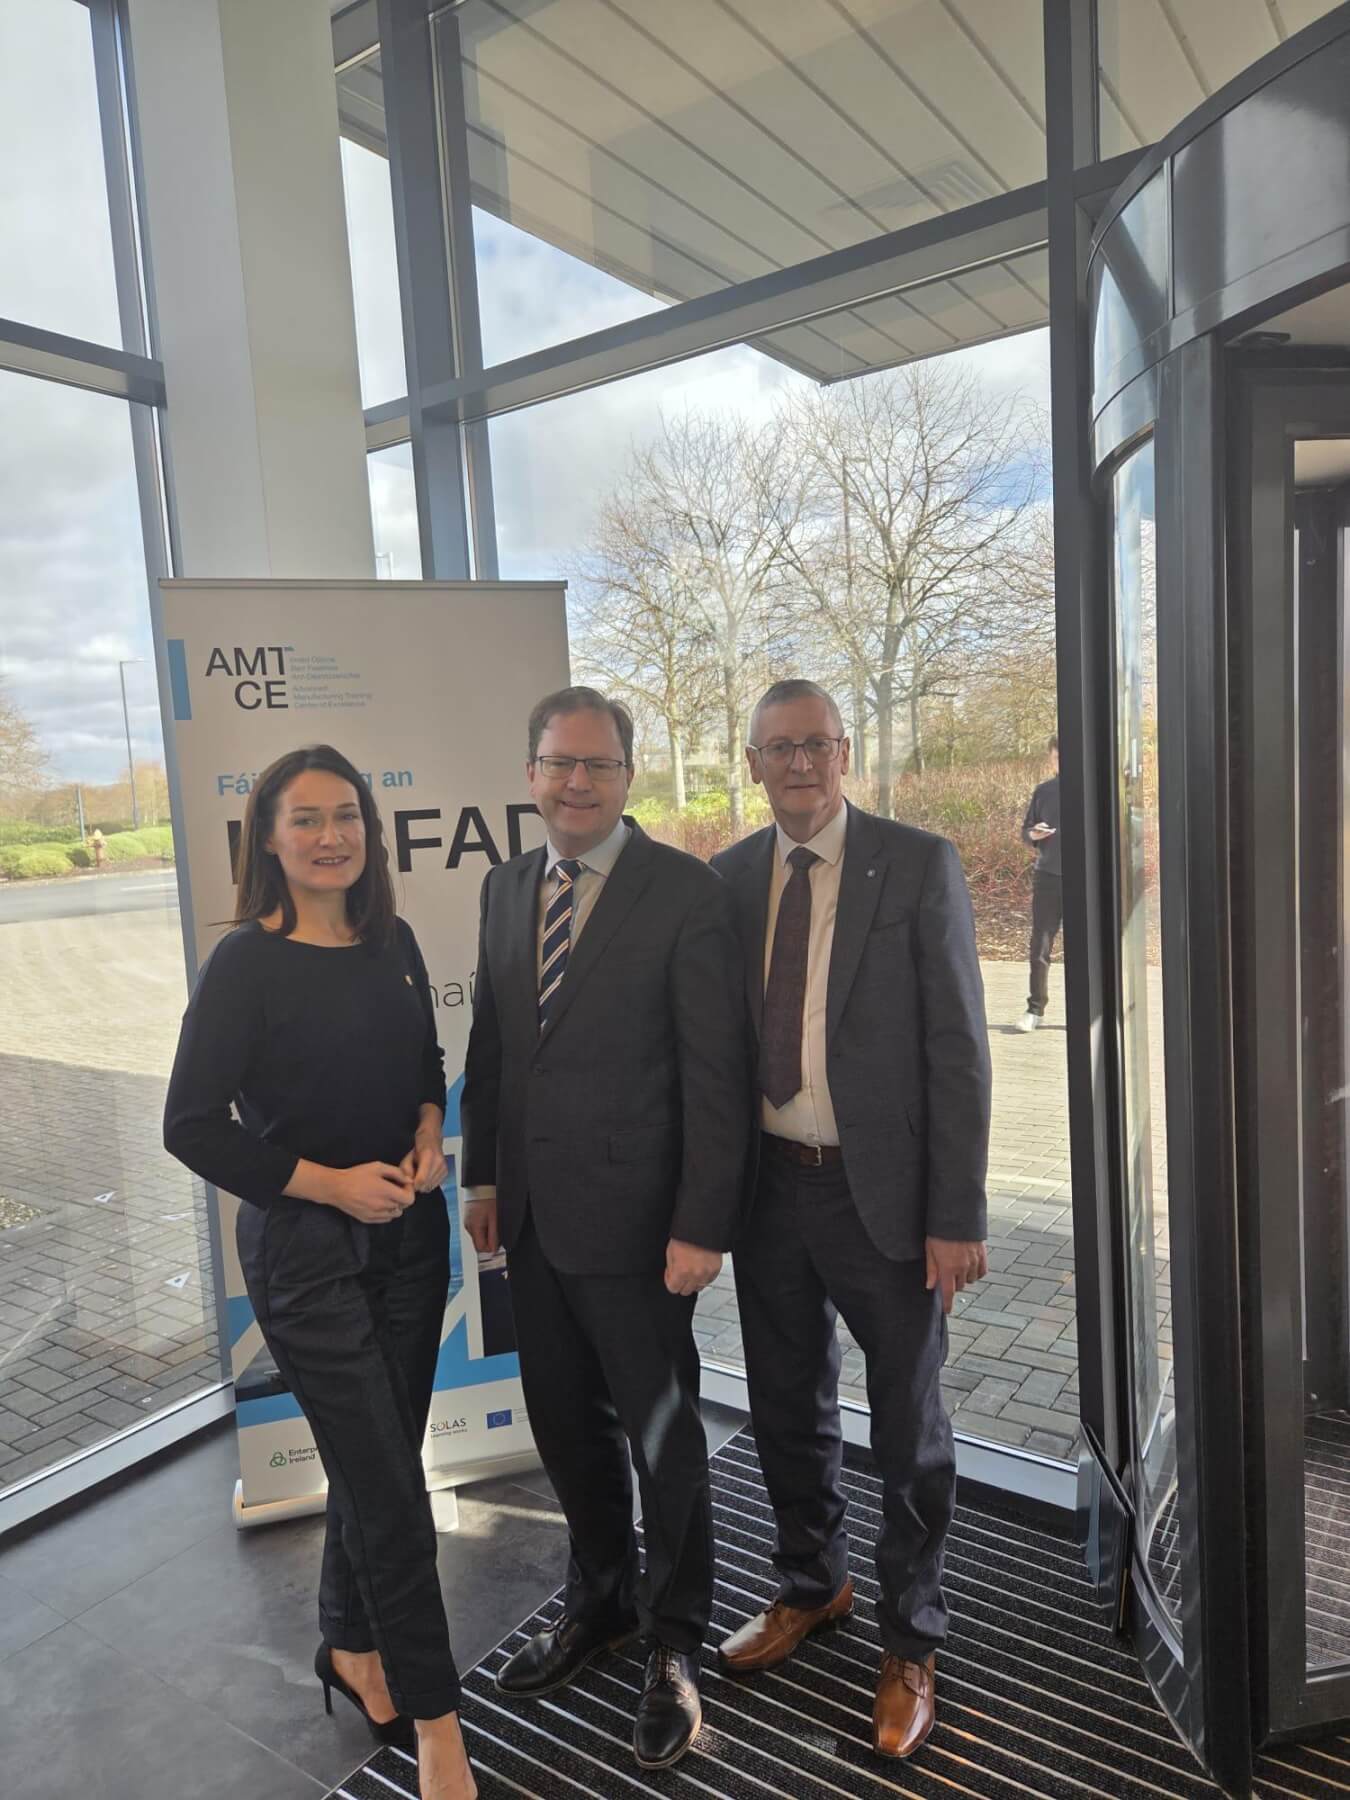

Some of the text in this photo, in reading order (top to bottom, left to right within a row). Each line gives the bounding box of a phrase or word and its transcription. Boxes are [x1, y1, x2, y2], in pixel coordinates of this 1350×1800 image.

[205, 647, 286, 676] AMT
[234, 680, 288, 710] CE
[217, 775, 257, 796] Fái
[382, 770, 413, 787] an
[430, 1417, 467, 1432] SOLAS
[289, 1454, 315, 1464] Ireland
